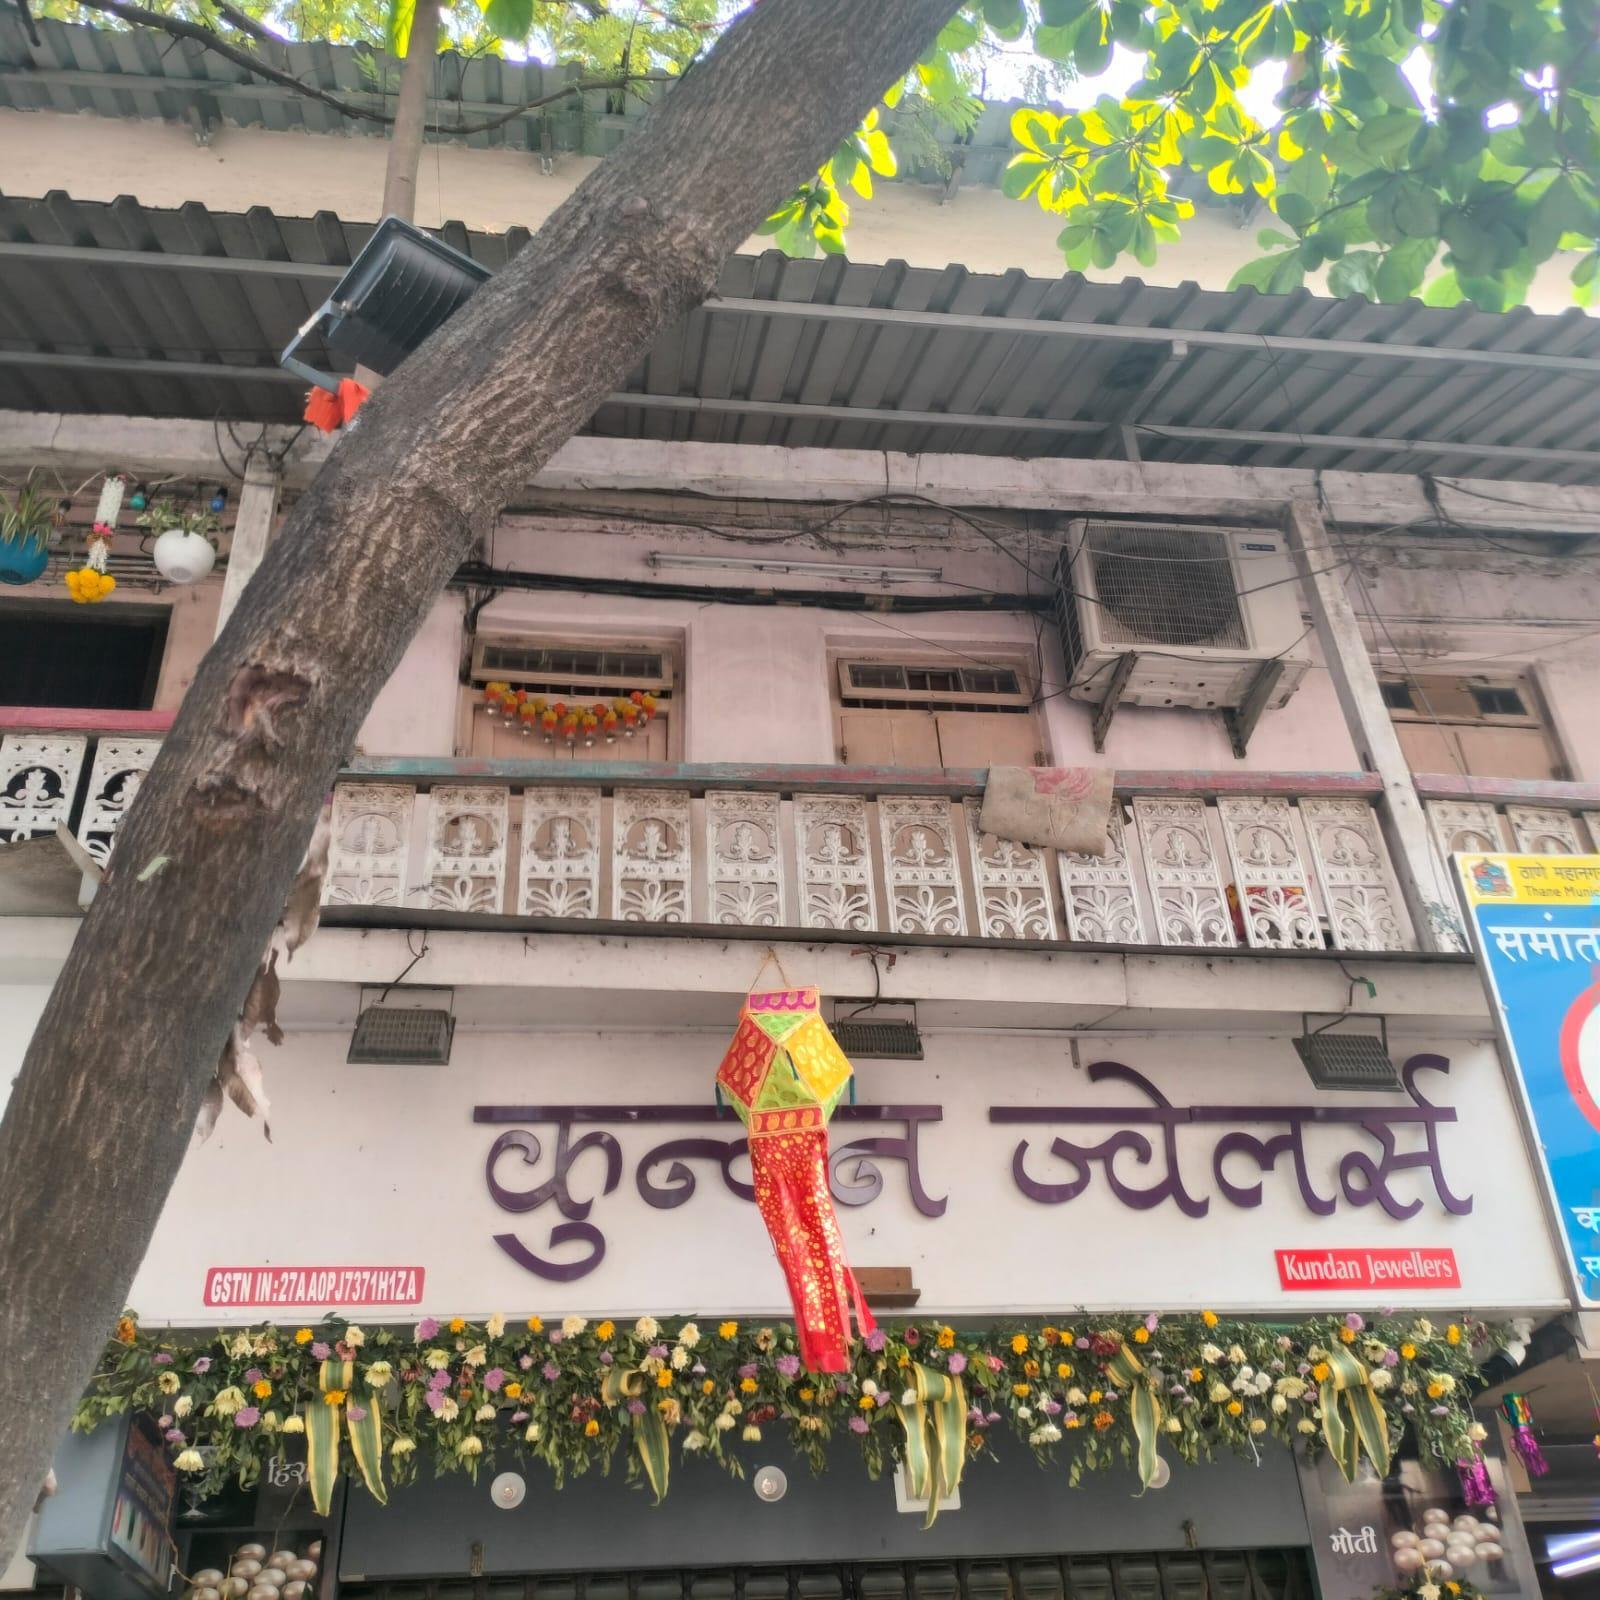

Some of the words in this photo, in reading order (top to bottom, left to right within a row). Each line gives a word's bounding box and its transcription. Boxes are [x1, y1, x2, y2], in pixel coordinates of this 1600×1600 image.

[1523, 885, 1561, 897] Thane
[1283, 1253, 1362, 1281] Kundan
[1365, 1252, 1453, 1285] Jewellers
[210, 1271, 253, 1303] GSTN
[1328, 1525, 1378, 1554] मोती
